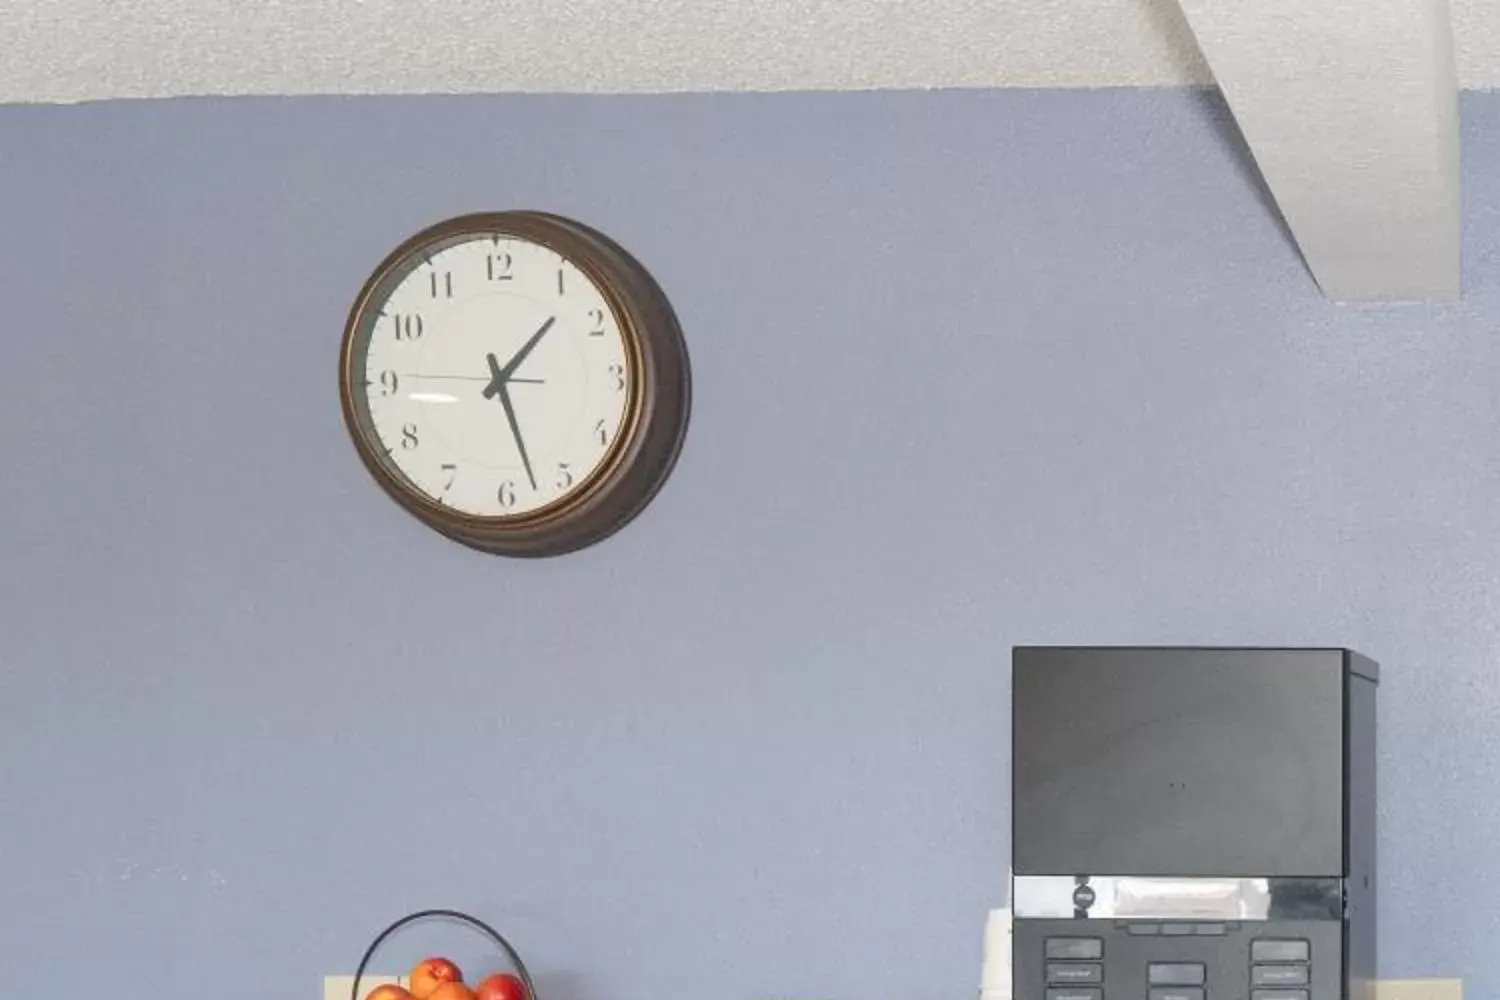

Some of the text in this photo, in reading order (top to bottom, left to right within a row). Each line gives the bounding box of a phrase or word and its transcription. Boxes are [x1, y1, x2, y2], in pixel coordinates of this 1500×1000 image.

[486, 253, 513, 282] 12
[430, 271, 454, 299] 11
[556, 268, 565, 297] 1
[394, 313, 423, 342] 10
[588, 308, 606, 338] 2
[381, 370, 399, 397] 9
[607, 364, 625, 392] 3
[401, 423, 420, 450] 8
[594, 418, 608, 447] 4
[441, 463, 457, 491] 7
[557, 462, 573, 490] 5
[498, 481, 516, 508] 6
